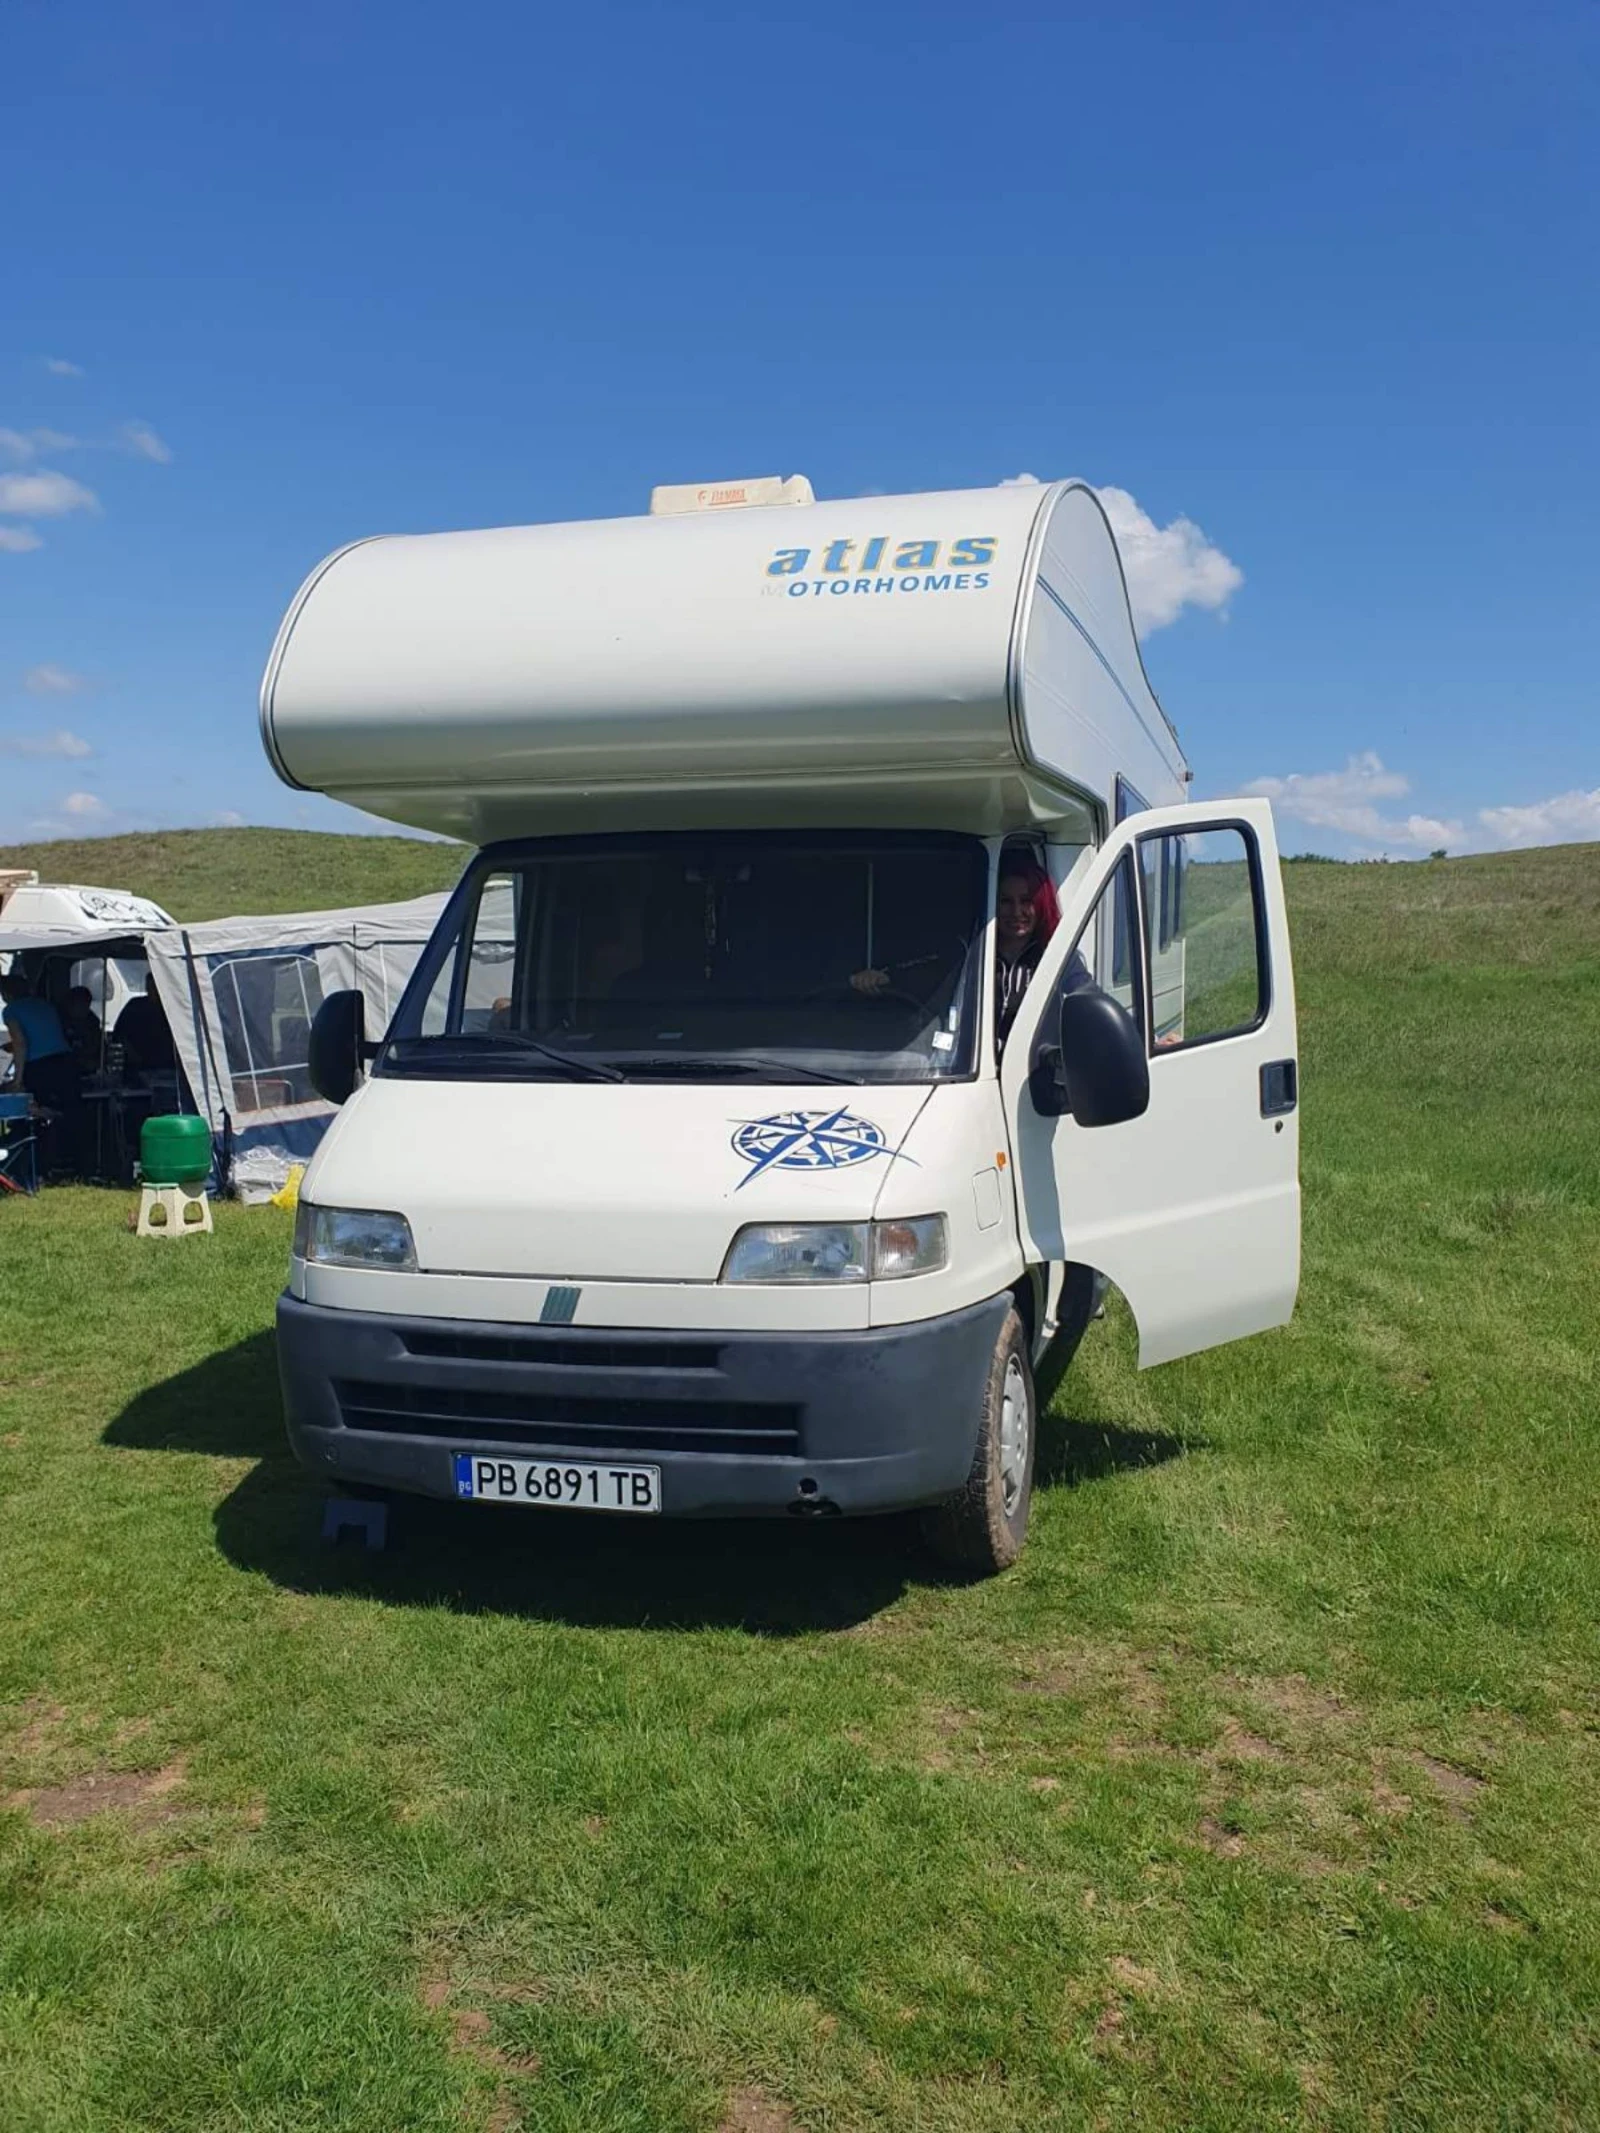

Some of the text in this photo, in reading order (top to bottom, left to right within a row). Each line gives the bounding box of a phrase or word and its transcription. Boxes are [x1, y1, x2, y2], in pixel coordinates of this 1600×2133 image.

[766, 536, 999, 577] atlas
[477, 1462, 653, 1506] PB 6891 TB
